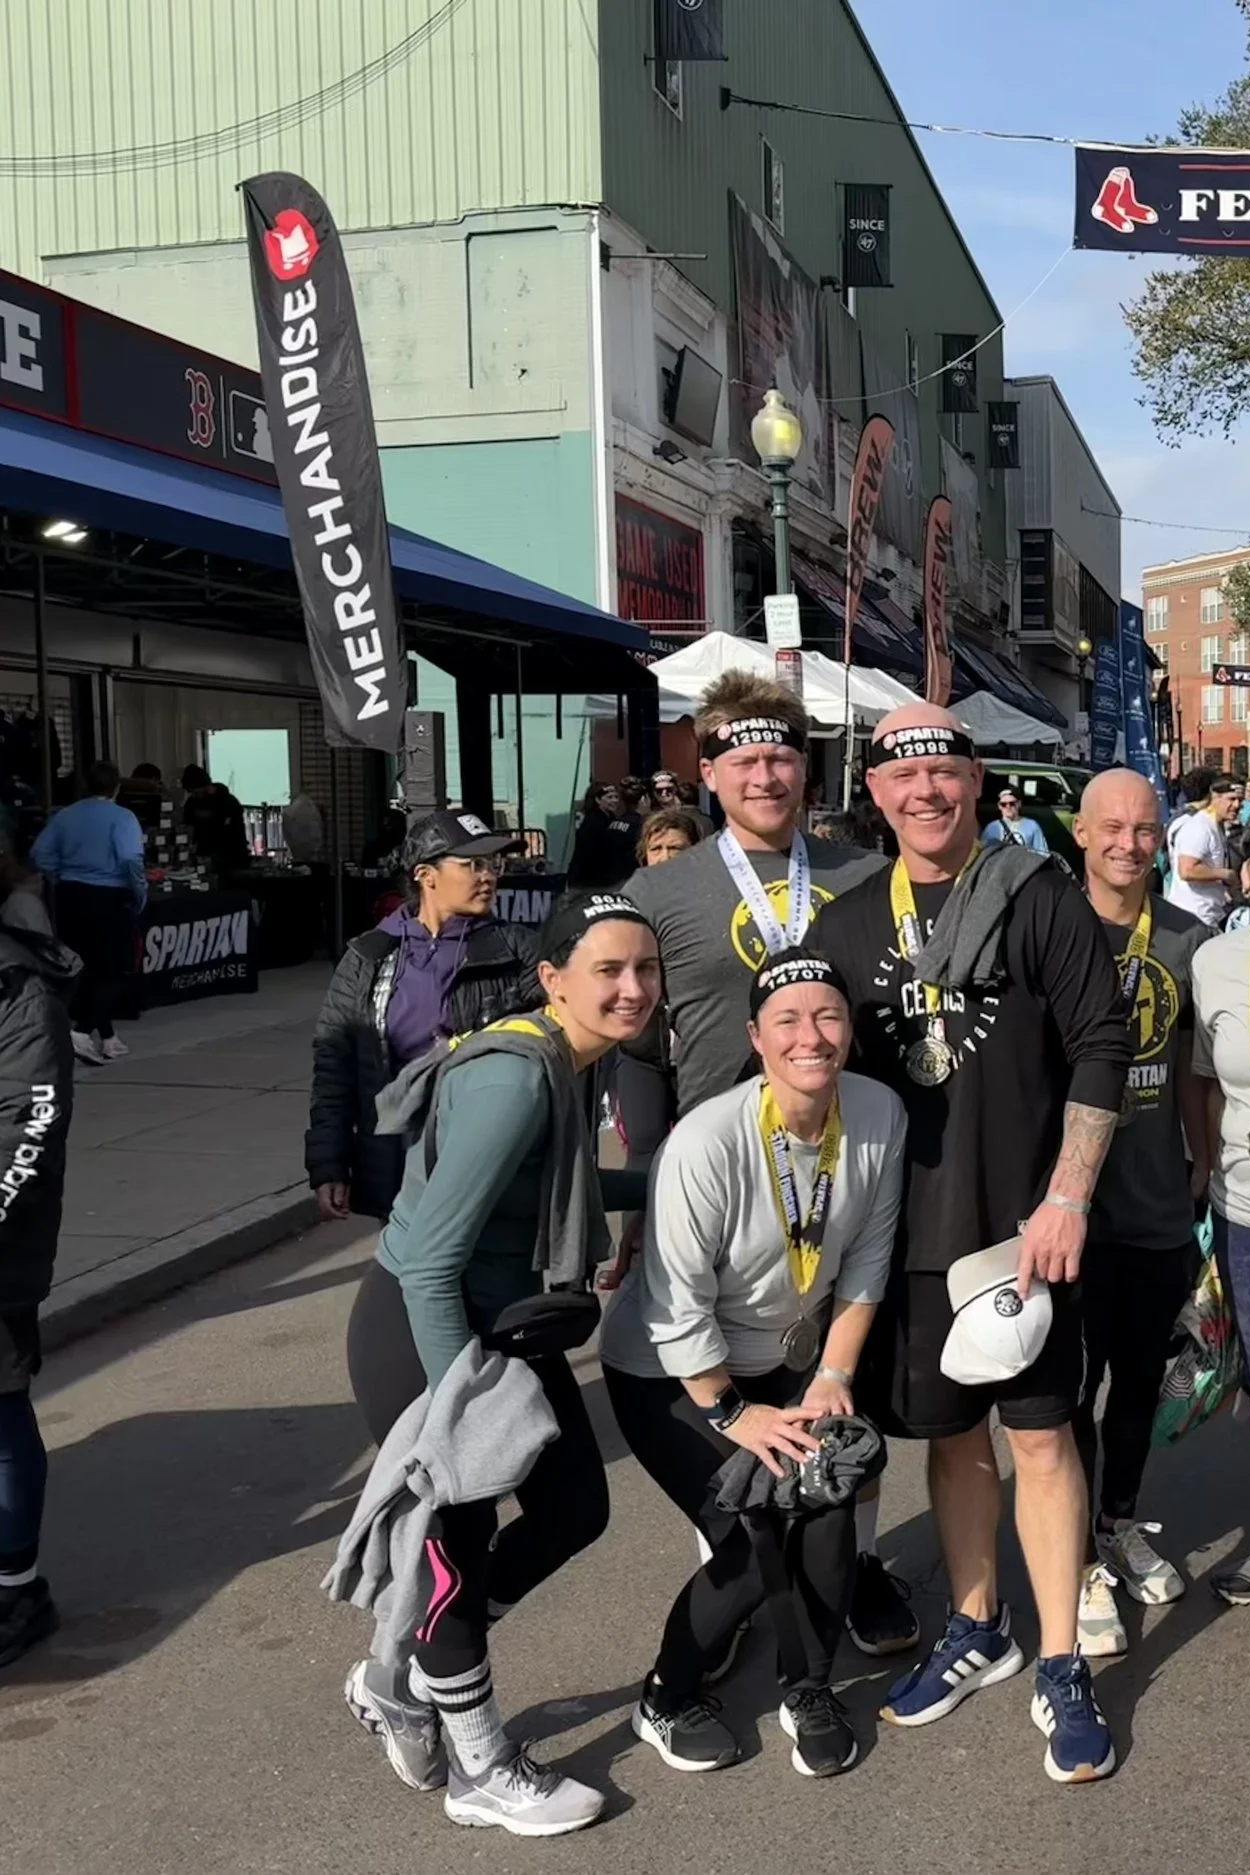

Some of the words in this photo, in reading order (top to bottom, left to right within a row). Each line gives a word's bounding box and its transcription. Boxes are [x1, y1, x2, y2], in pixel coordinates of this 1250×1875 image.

[849, 218, 886, 232] SINCE
[280, 279, 390, 721] MERCHANDISE
[730, 717, 790, 734] SPARTAN
[730, 731, 784, 746] 12999
[896, 727, 955, 744] SPARTAN
[894, 742, 949, 759] 12998
[143, 909, 249, 975] SPARTAN
[771, 958, 832, 977] SPARTAN
[767, 969, 825, 990] 14707
[22, 1084, 57, 1141] new
